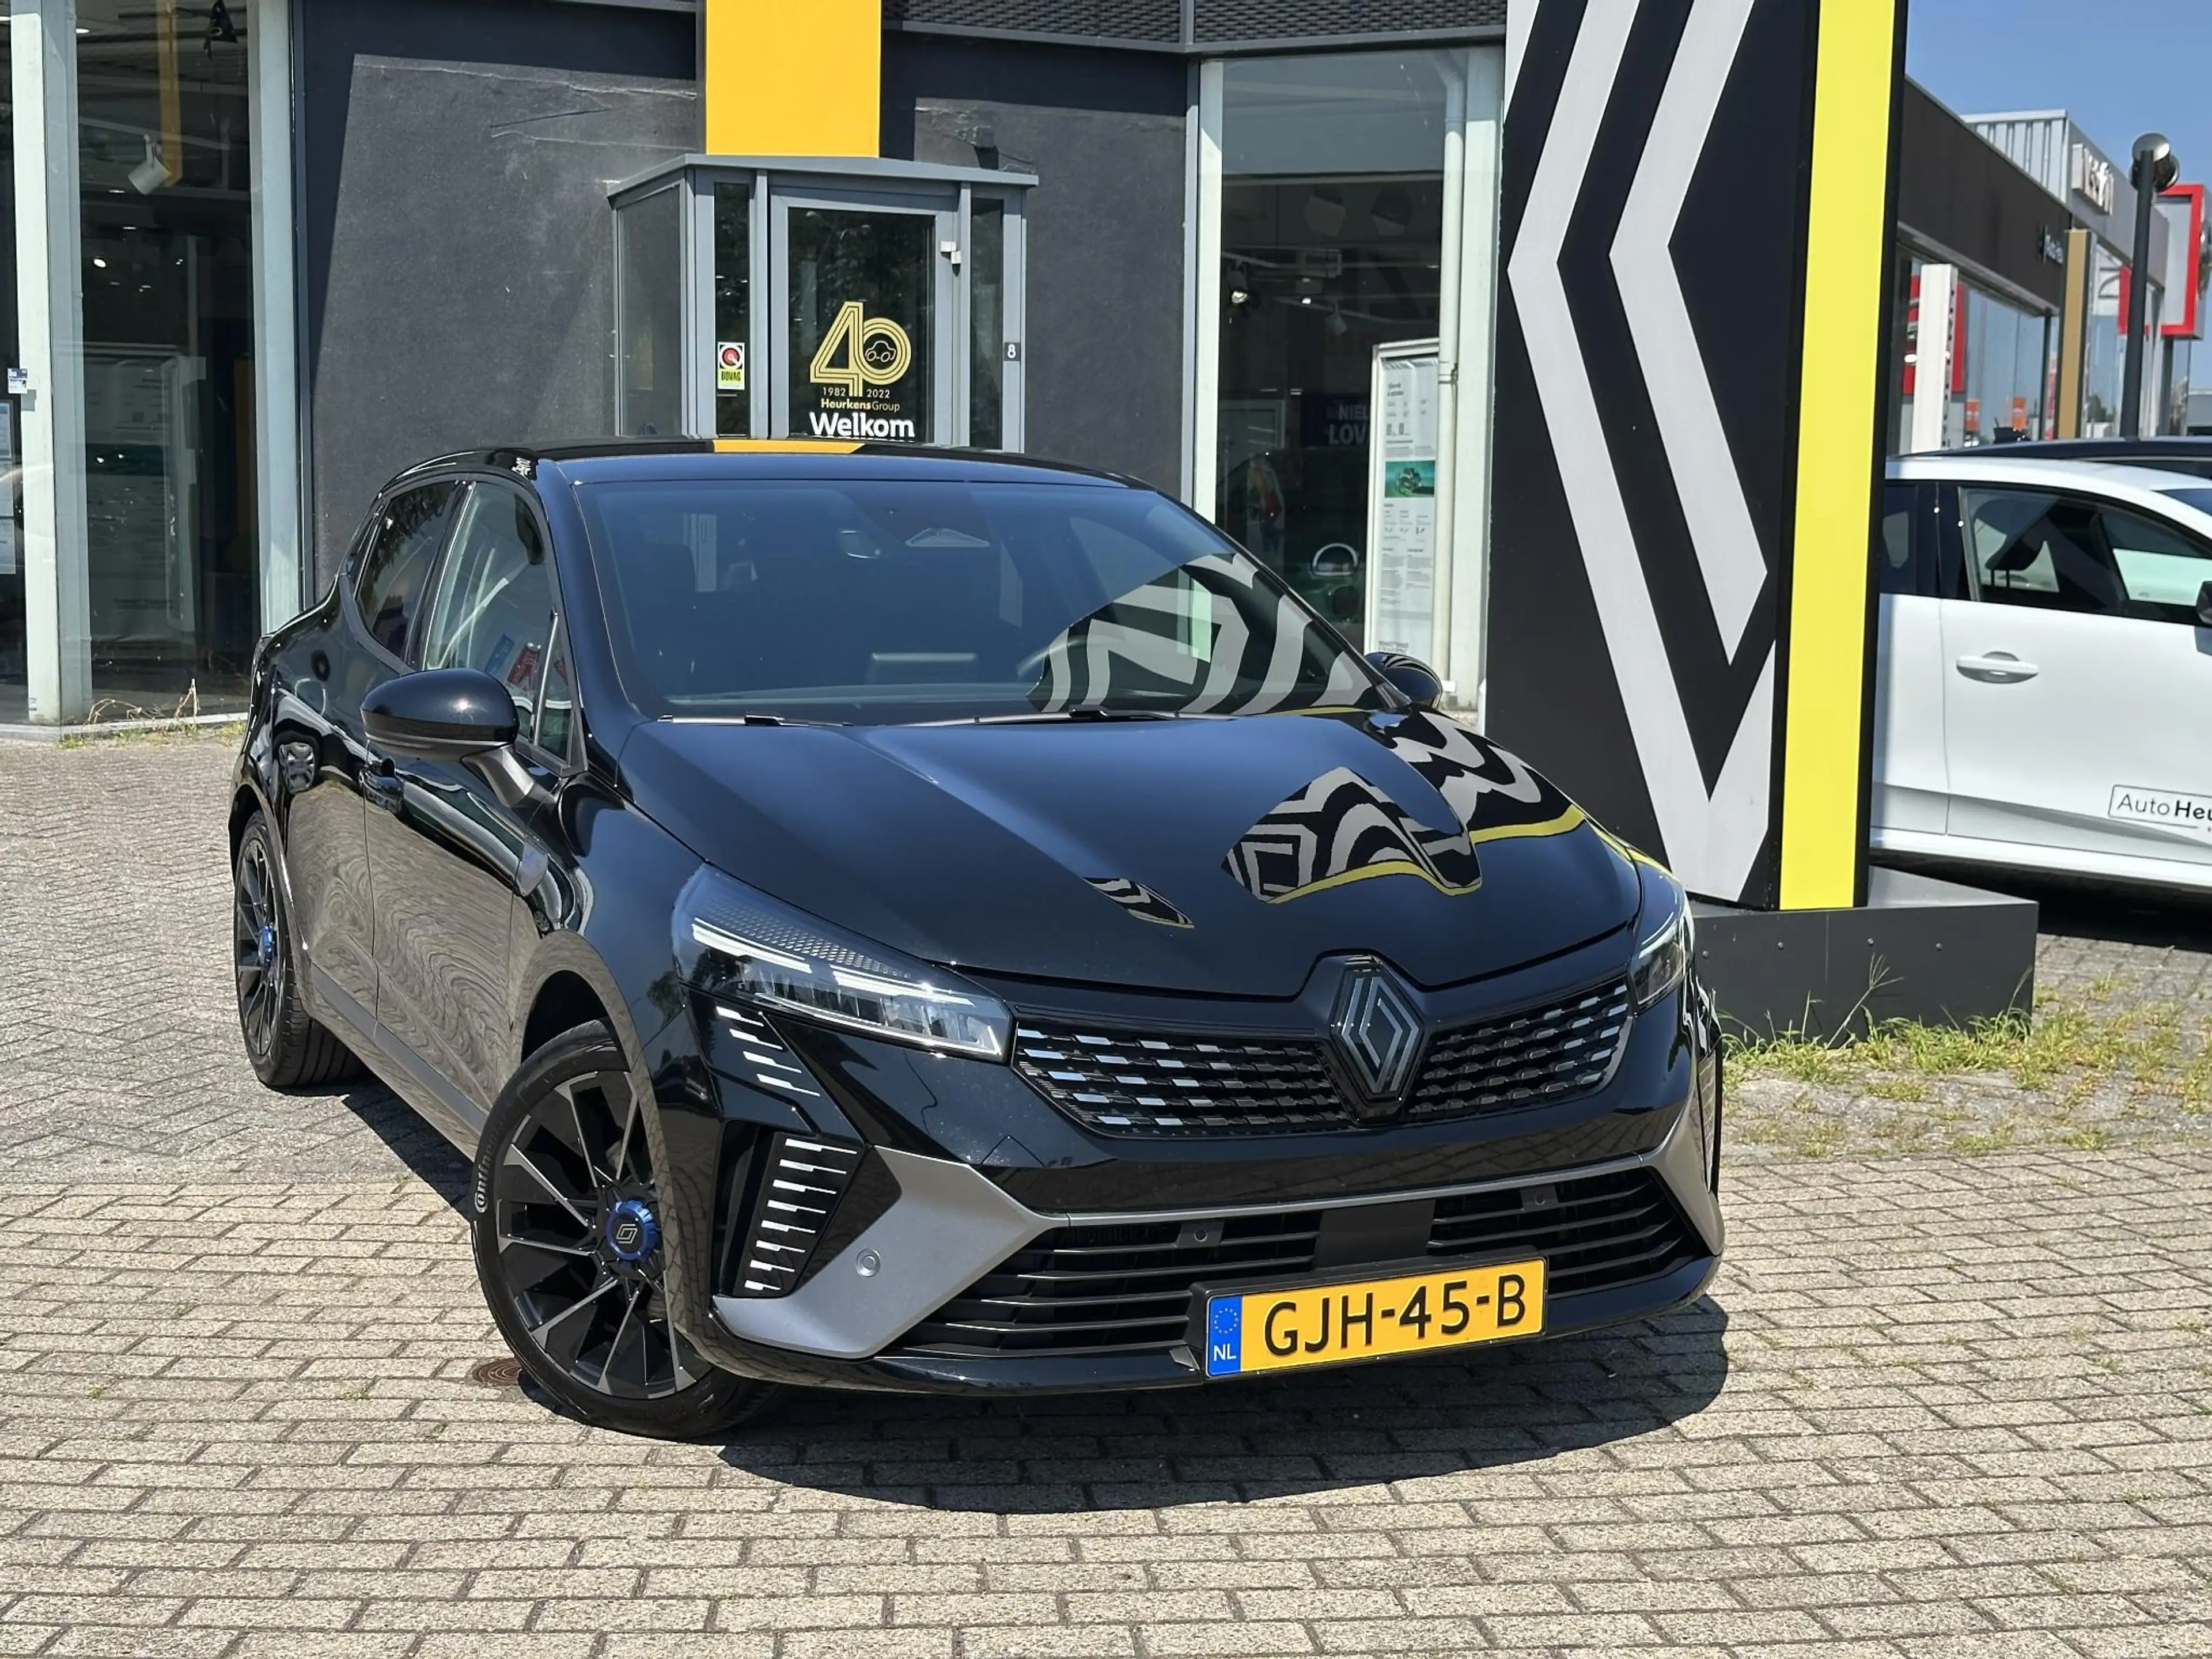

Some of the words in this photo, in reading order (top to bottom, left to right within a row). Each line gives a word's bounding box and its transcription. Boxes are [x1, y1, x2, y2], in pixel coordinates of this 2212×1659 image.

[1007, 344, 1016, 358] 8
[823, 387, 846, 396] 1982
[866, 389, 890, 399] 2022
[809, 411, 915, 437] Welkom
[1264, 1274, 1526, 1356] GJH-45-B
[1213, 1344, 1237, 1361] NL
